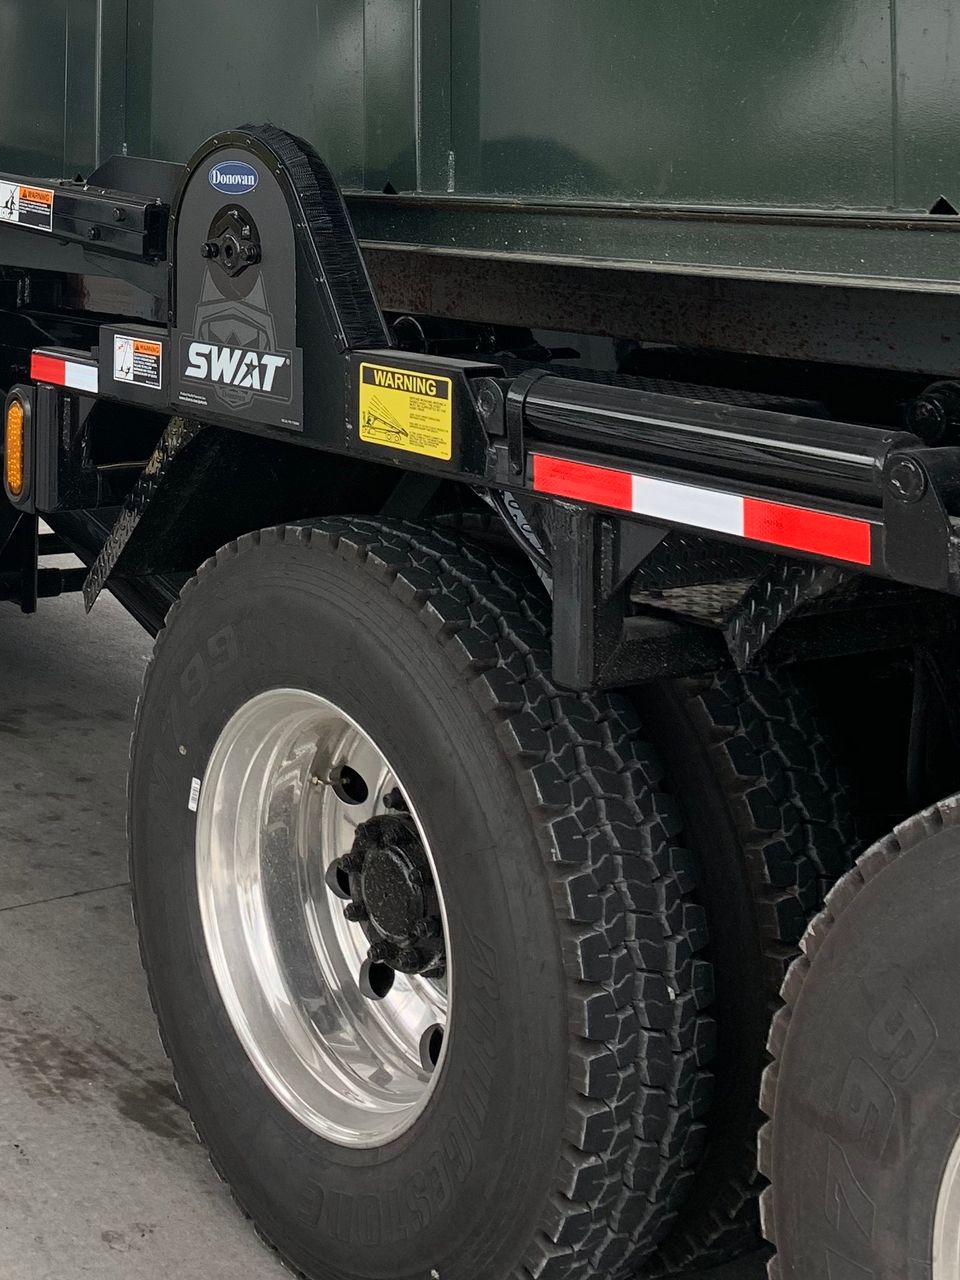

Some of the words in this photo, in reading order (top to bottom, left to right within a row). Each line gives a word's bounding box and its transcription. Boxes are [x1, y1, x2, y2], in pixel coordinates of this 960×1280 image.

[212, 169, 255, 185] Donovan
[184, 342, 286, 392] SWAT
[373, 369, 437, 396] WARNING
